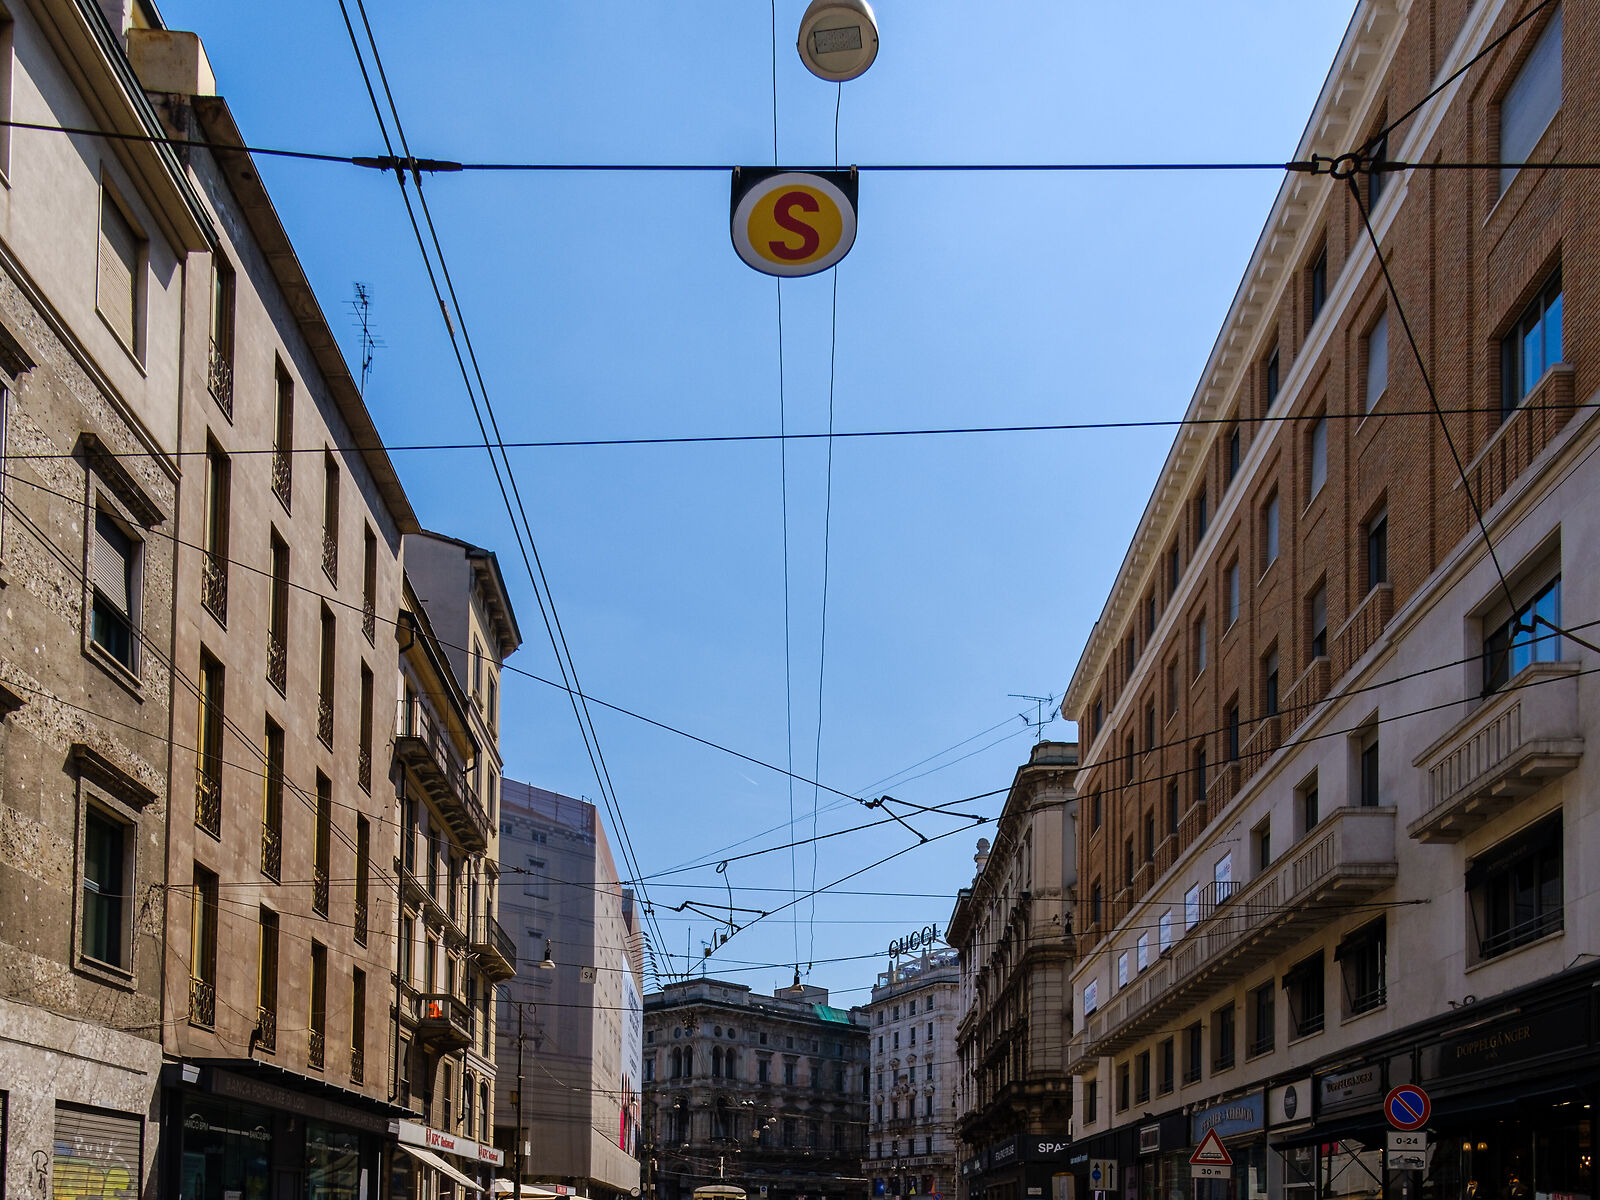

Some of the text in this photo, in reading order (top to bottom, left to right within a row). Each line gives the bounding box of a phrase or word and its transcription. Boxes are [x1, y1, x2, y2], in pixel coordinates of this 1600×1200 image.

[768, 191, 820, 260] S
[889, 923, 936, 959] GUCCI
[1038, 1143, 1069, 1153] SPA
[1396, 1137, 1418, 1145] 0-24
